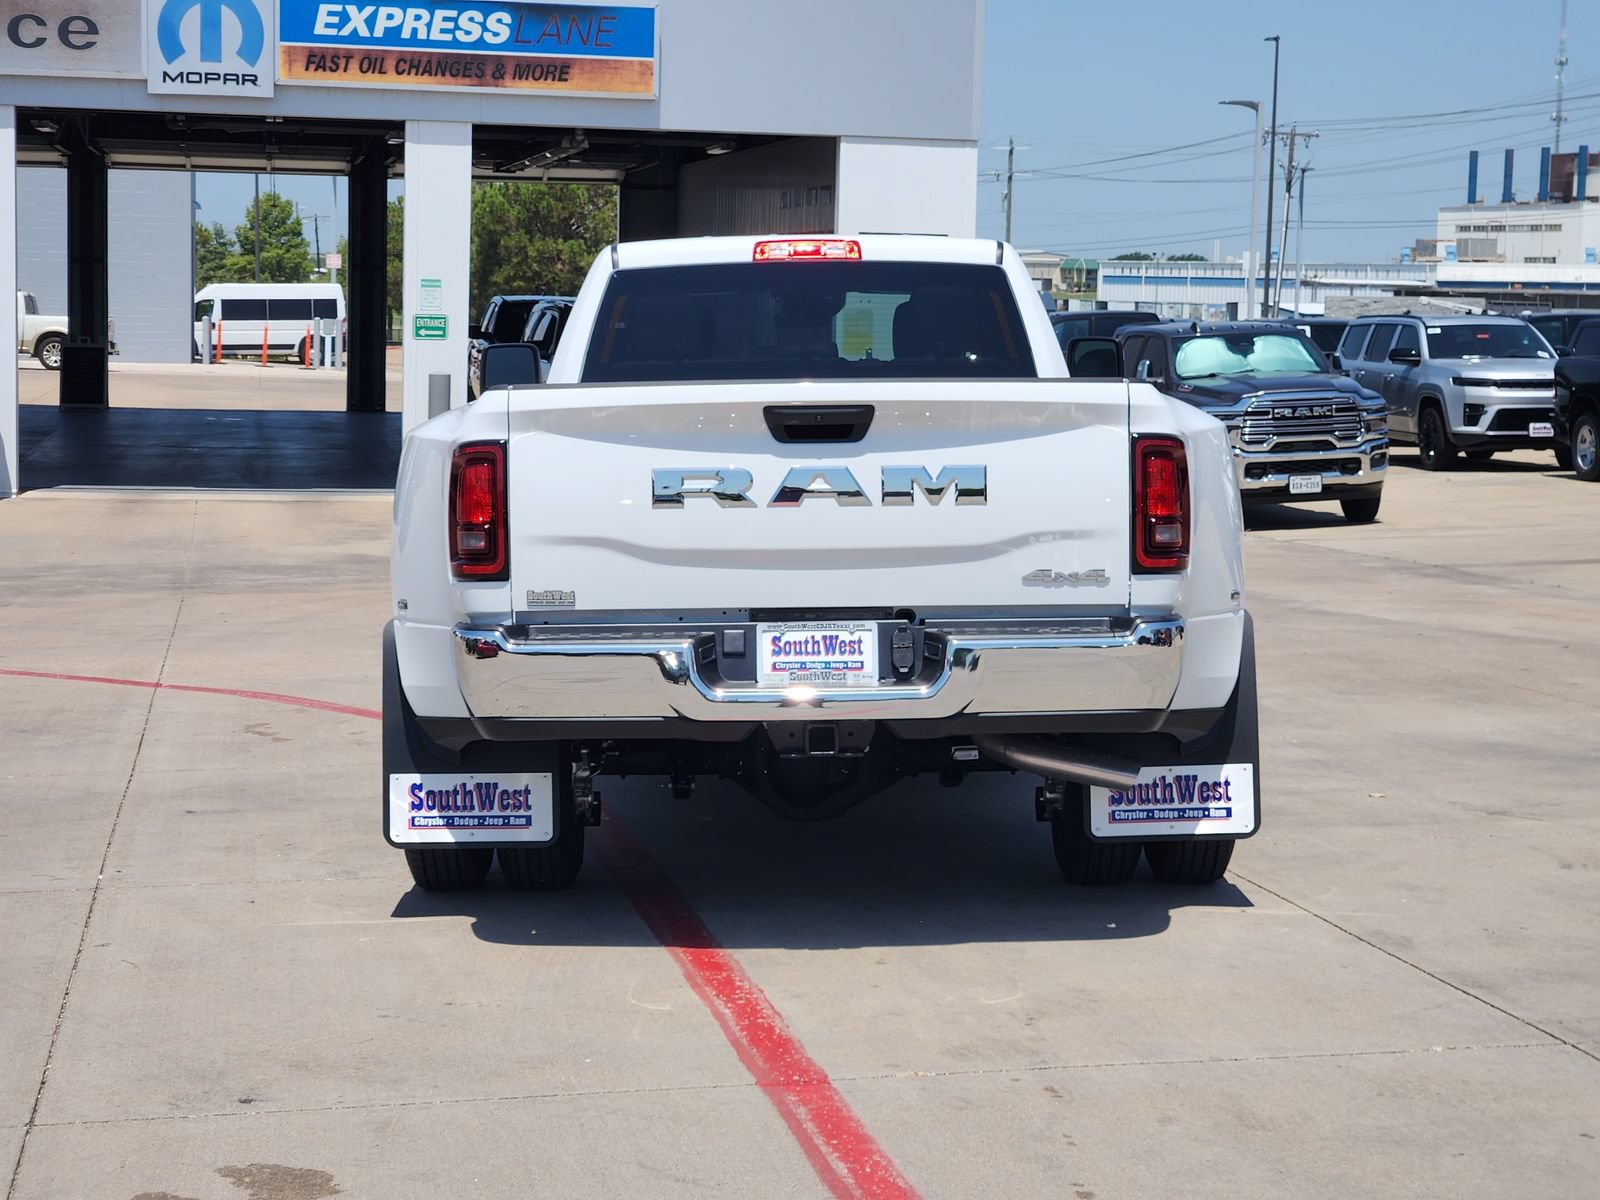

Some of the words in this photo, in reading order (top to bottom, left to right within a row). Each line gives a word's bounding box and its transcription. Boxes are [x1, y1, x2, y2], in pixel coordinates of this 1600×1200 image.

[313, 4, 512, 44] EXPRESS
[514, 12, 617, 48] LANE
[304, 54, 353, 73] FAST
[359, 56, 387, 75] OIL
[395, 57, 486, 79] CHANGES
[491, 62, 505, 80] &
[512, 63, 571, 82] MORE
[162, 71, 259, 86] MOPAR
[416, 318, 446, 327] ENTRANCE
[1274, 406, 1332, 418] RAM
[650, 464, 988, 510] RAM
[771, 634, 864, 657] SouthWest
[775, 662, 801, 670] Chrysler
[806, 662, 825, 670] Dodge
[789, 671, 848, 681] SouthWest
[408, 782, 532, 812] SouthWest
[1114, 810, 1147, 820] Chrysler
[1154, 809, 1179, 819] Dodge
[1184, 808, 1203, 818] Jeep
[1210, 808, 1227, 817] Ram
[414, 817, 447, 826] Chrysler
[454, 817, 478, 826] Dodge
[484, 817, 503, 826] Jeep
[509, 816, 526, 825] Ram
